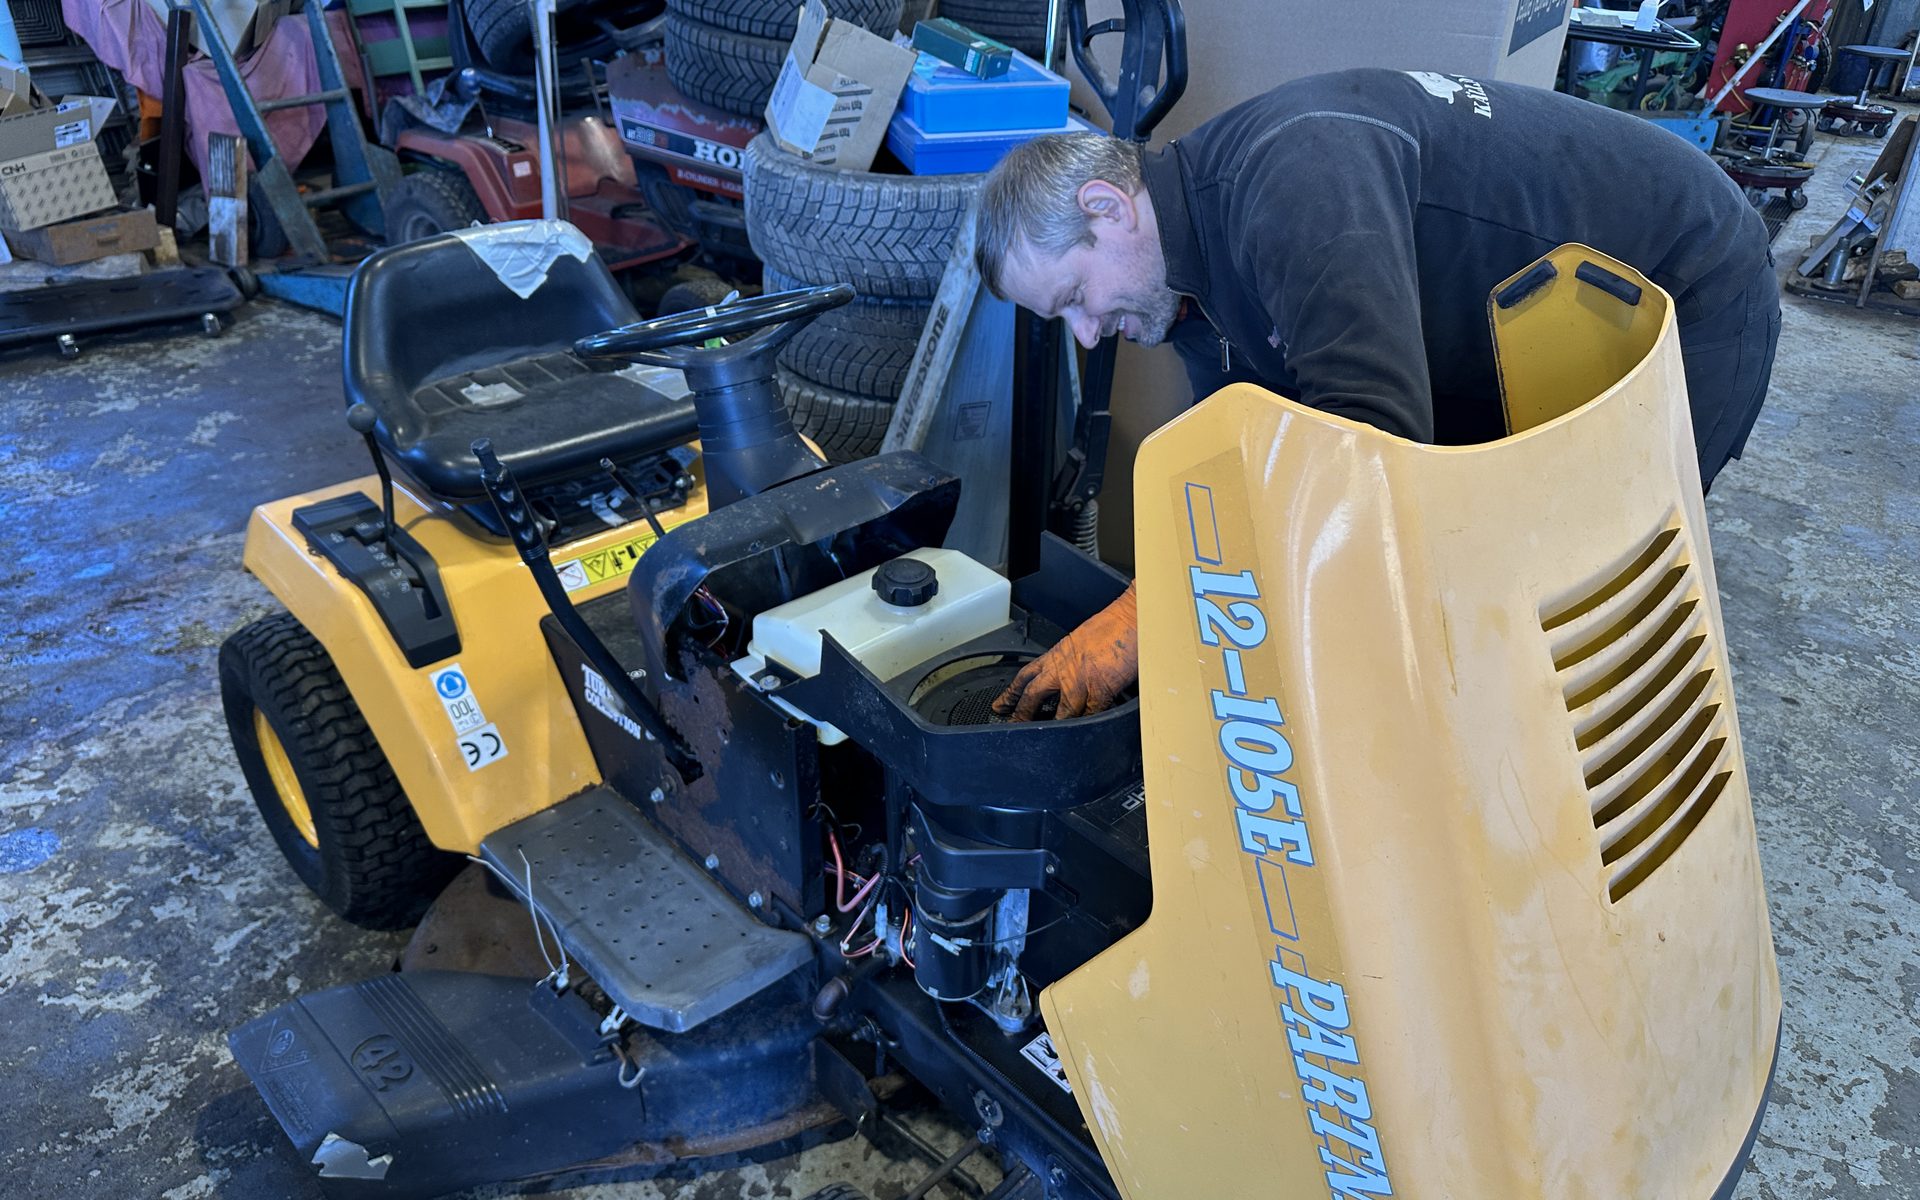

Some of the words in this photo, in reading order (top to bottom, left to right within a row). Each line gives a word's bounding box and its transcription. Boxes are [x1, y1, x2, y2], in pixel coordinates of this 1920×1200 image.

[1, 161, 27, 176] CNH
[449, 697, 476, 720] 100
[1189, 565, 1316, 866] 12-105E
[461, 732, 501, 767] CE
[357, 1046, 414, 1092] 42
